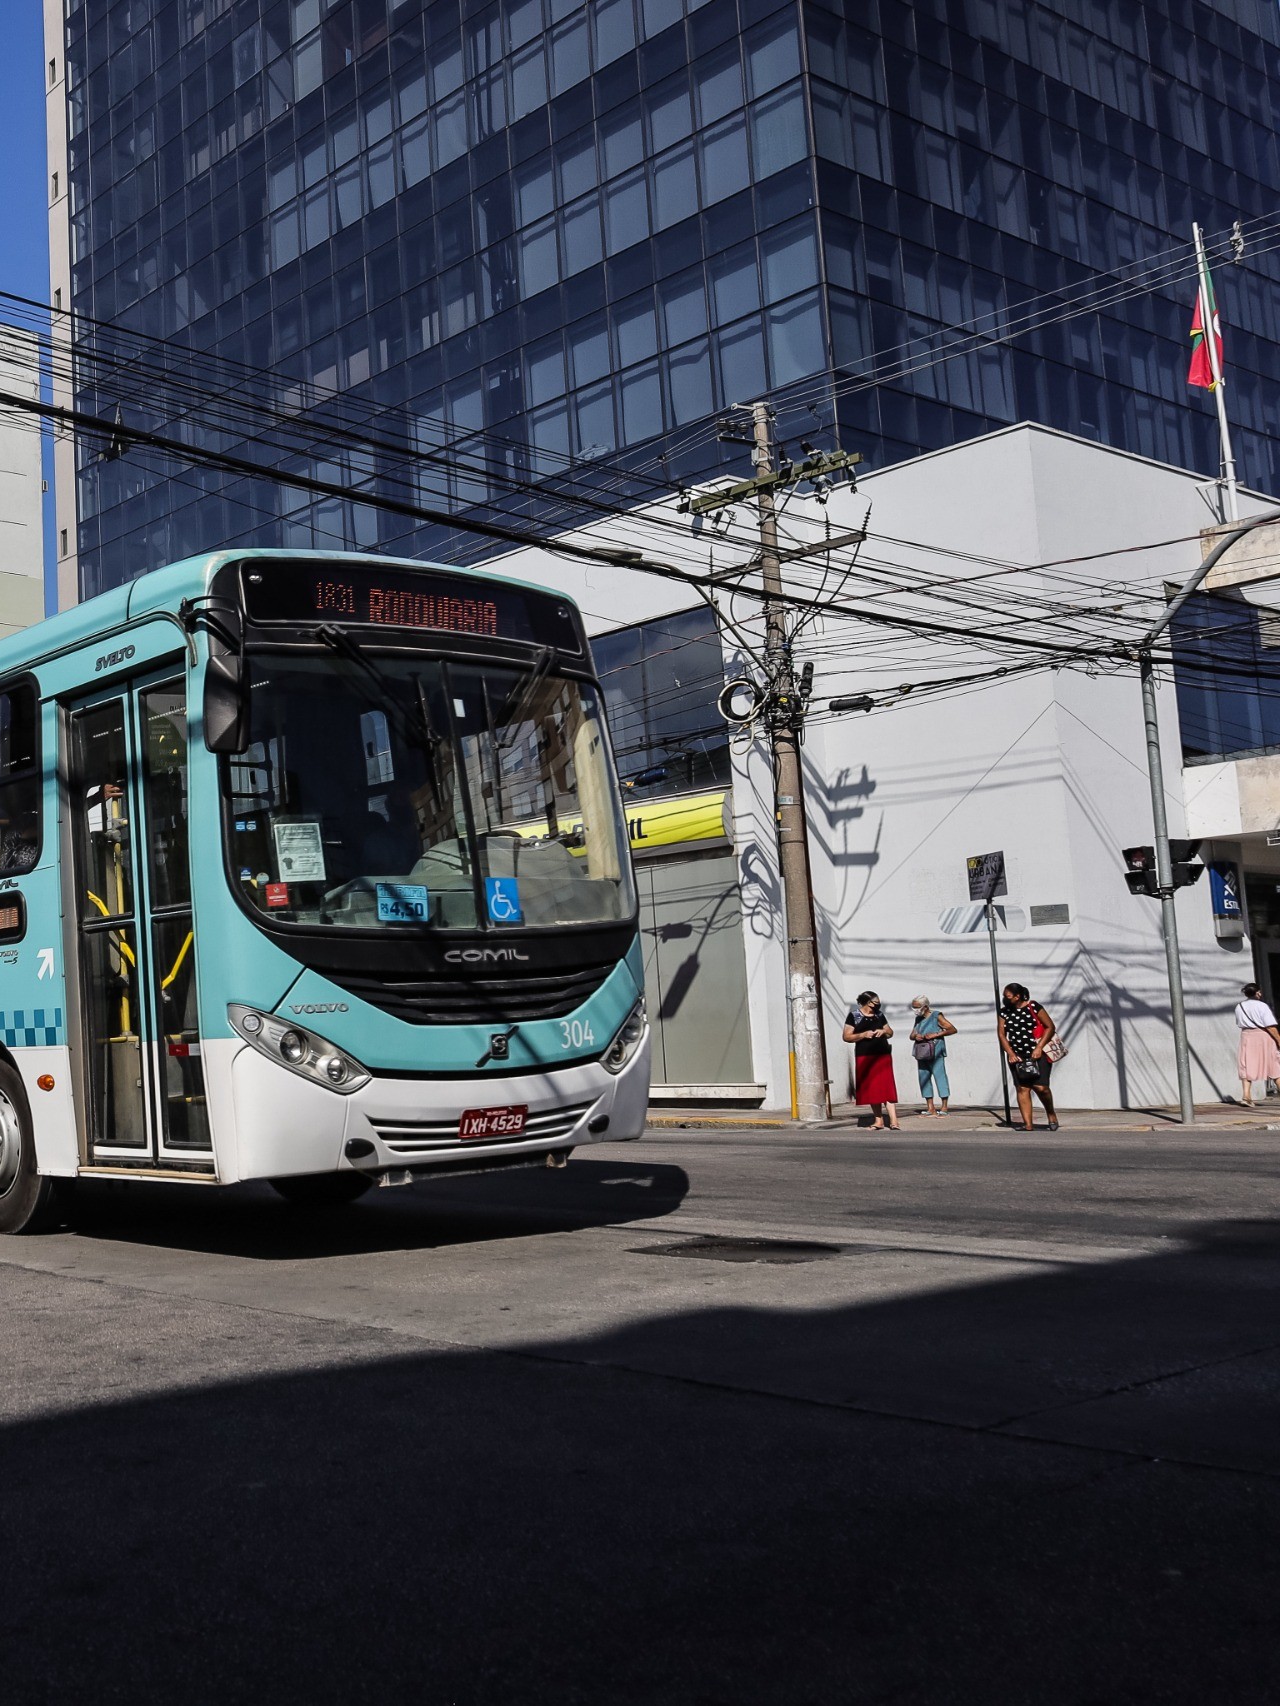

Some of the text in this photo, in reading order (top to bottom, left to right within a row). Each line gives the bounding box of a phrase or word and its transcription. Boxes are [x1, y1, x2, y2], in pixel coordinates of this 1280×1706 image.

[95, 645, 136, 671] SVELTO
[390, 901, 424, 919] 4,50
[444, 949, 529, 963] COMIL
[288, 1003, 349, 1015] VOLVO
[560, 1020, 595, 1049] 304
